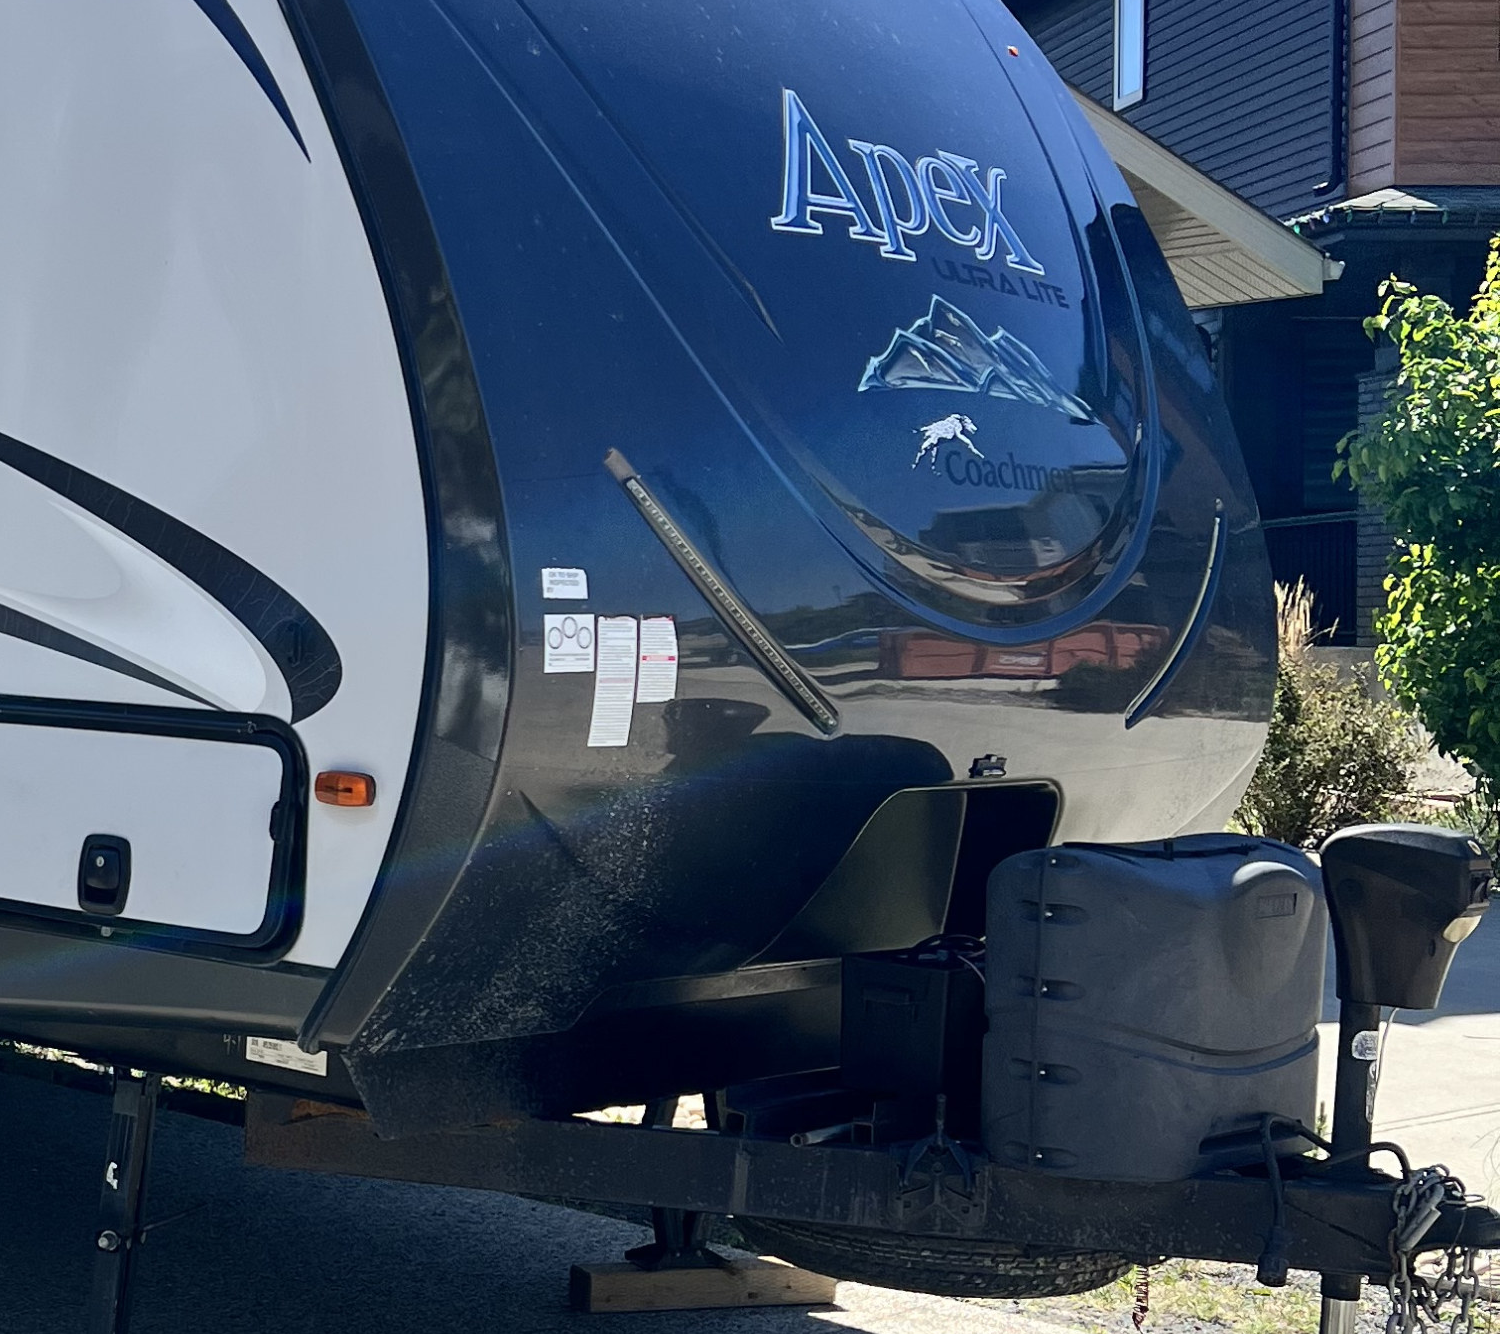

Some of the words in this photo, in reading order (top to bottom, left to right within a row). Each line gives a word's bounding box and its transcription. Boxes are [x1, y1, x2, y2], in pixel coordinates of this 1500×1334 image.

[770, 87, 1045, 275] Apex
[931, 256, 1020, 297] ULTRA
[1019, 276, 1070, 309] LITE
[945, 450, 1075, 494] Coachmen
